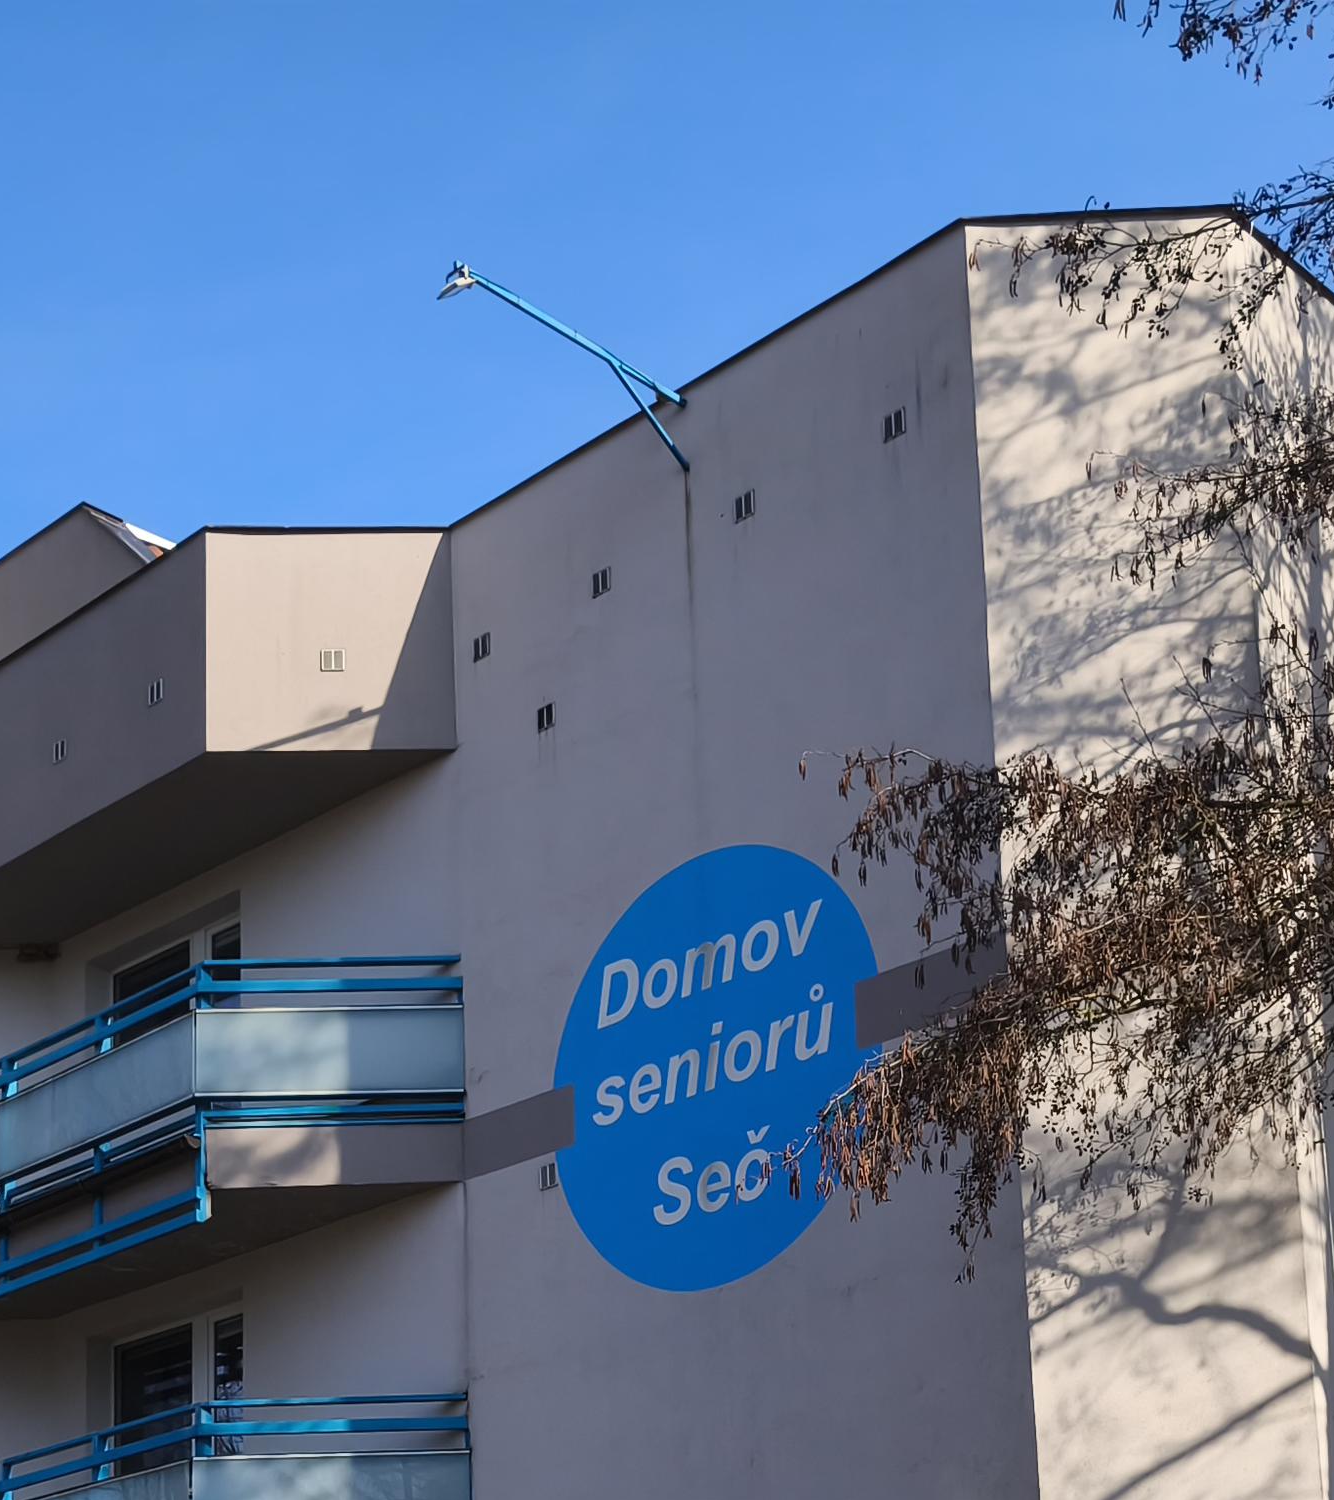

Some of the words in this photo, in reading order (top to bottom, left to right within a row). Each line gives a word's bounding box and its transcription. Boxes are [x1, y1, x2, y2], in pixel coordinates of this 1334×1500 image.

[597, 899, 822, 1030] Domov
[592, 983, 834, 1127] seniorů
[653, 1125, 770, 1226] Seč
